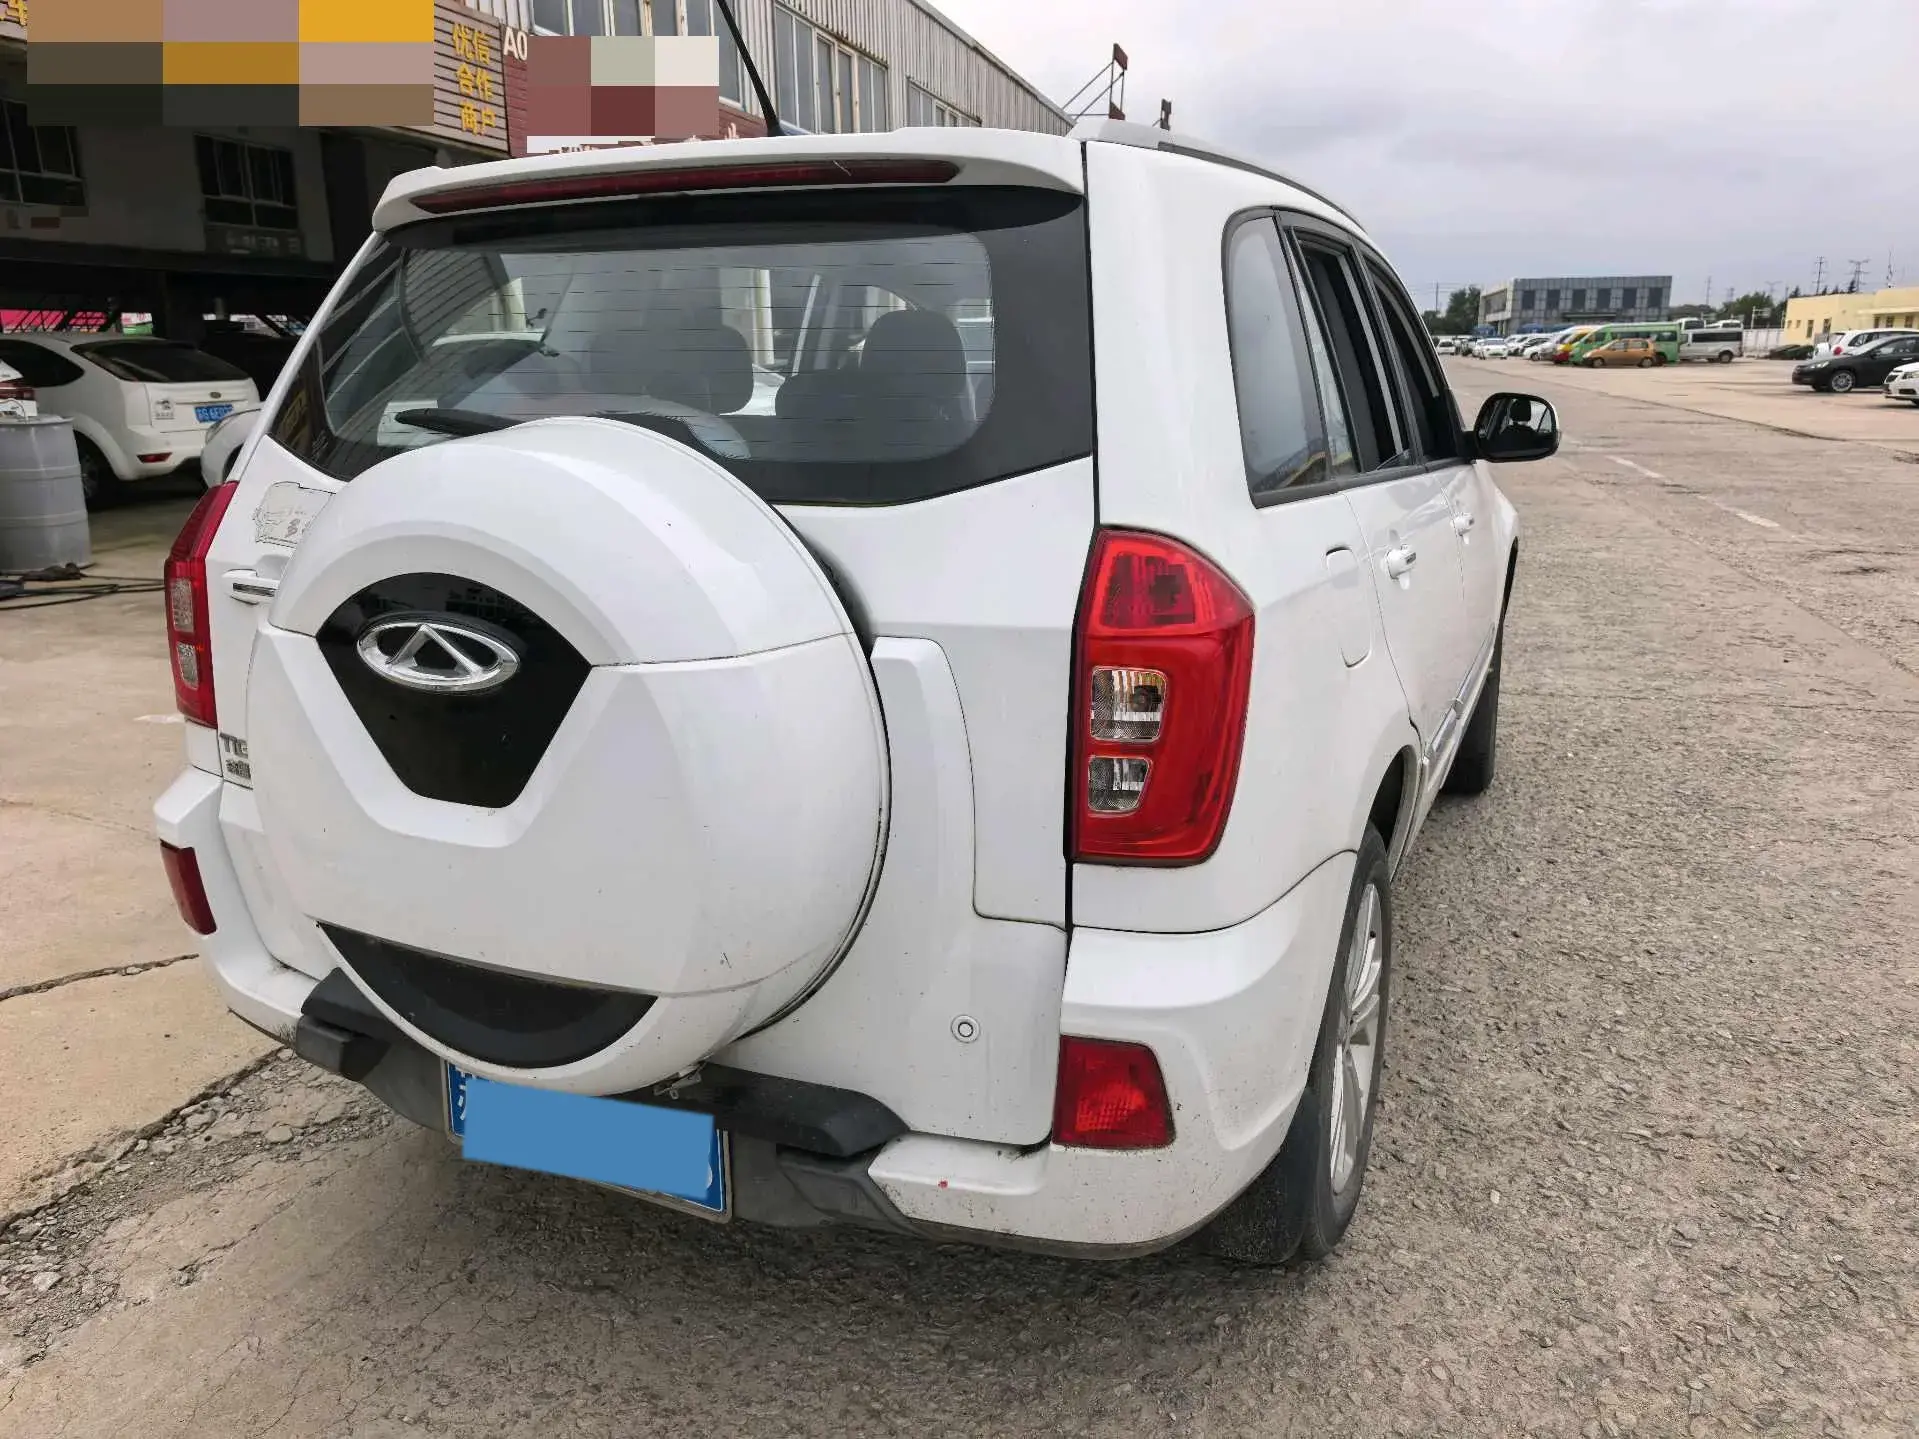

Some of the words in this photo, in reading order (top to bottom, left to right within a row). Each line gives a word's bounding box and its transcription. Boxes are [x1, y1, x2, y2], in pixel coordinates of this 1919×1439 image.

[452, 23, 490, 65] 优信
[456, 62, 494, 100] 合作
[461, 99, 496, 136] 商户
